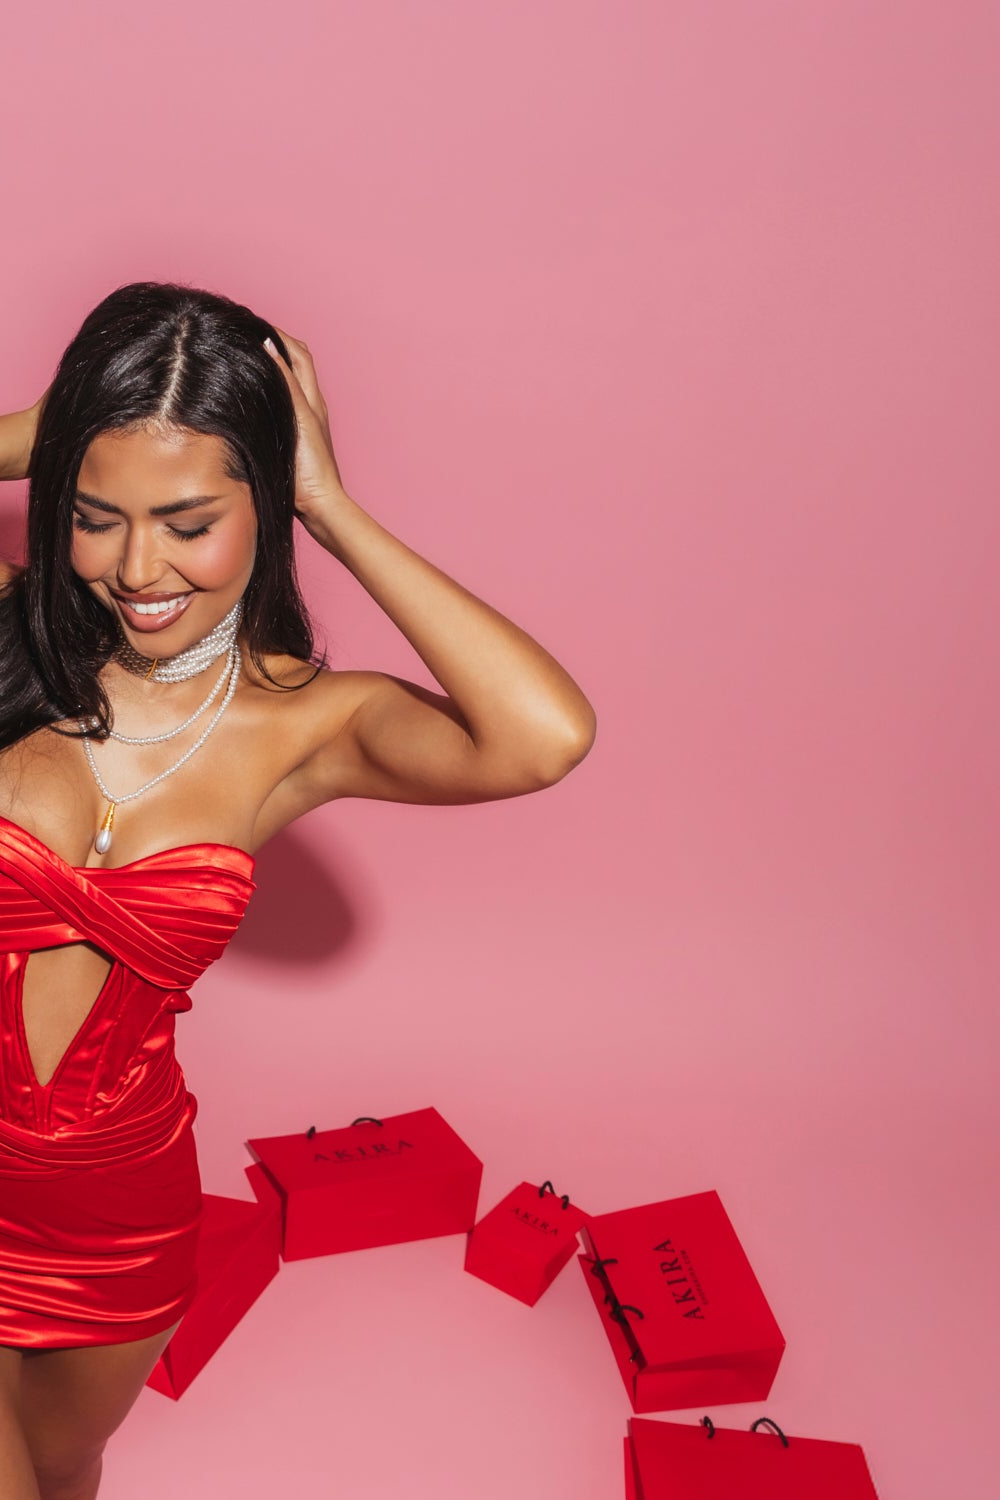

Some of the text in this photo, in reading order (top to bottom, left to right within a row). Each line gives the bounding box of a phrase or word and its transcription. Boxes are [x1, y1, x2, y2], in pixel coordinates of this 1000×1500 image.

[314, 1140, 414, 1162] AKIRA
[512, 1209, 558, 1235] AKIRA
[654, 1240, 704, 1320] AKIRA
